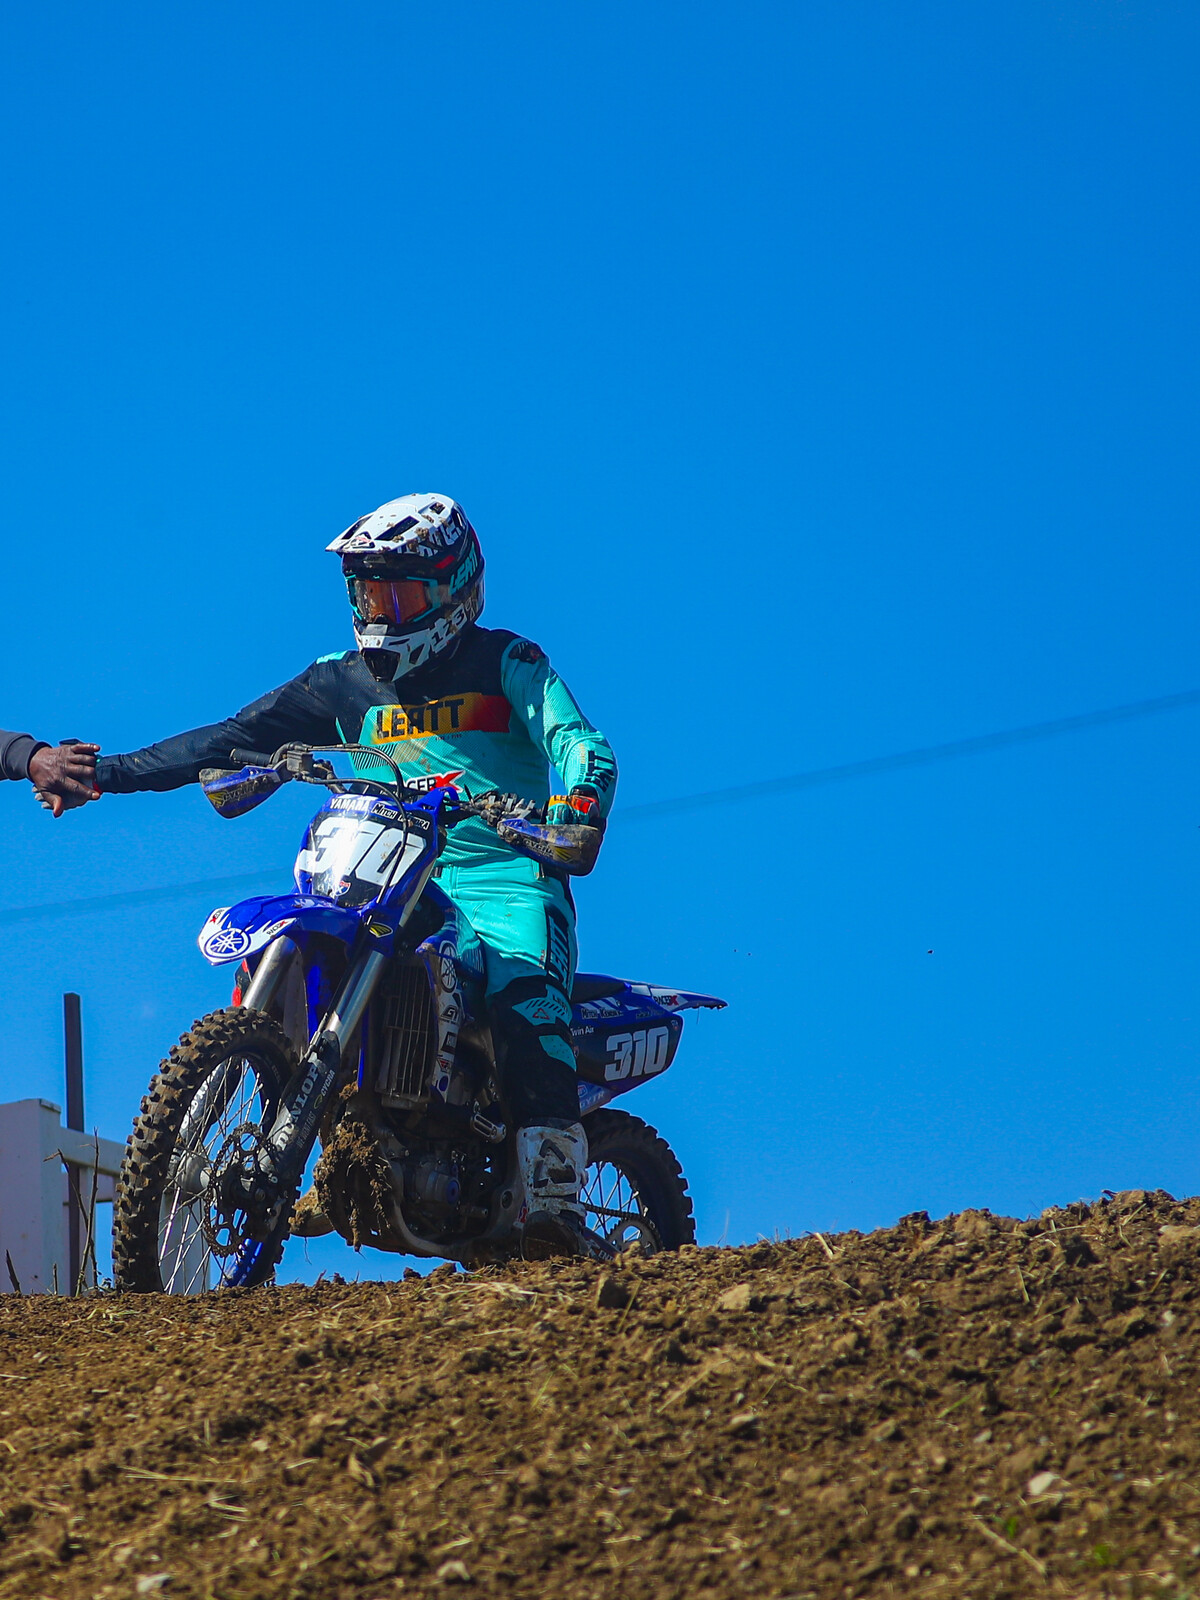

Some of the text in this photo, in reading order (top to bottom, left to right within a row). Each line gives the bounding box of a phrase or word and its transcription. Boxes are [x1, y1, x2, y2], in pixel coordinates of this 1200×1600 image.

[376, 698, 465, 739] LEATT
[330, 798, 371, 812] YAMAHA
[585, 1026, 594, 1035] Air
[604, 1025, 670, 1082] 310
